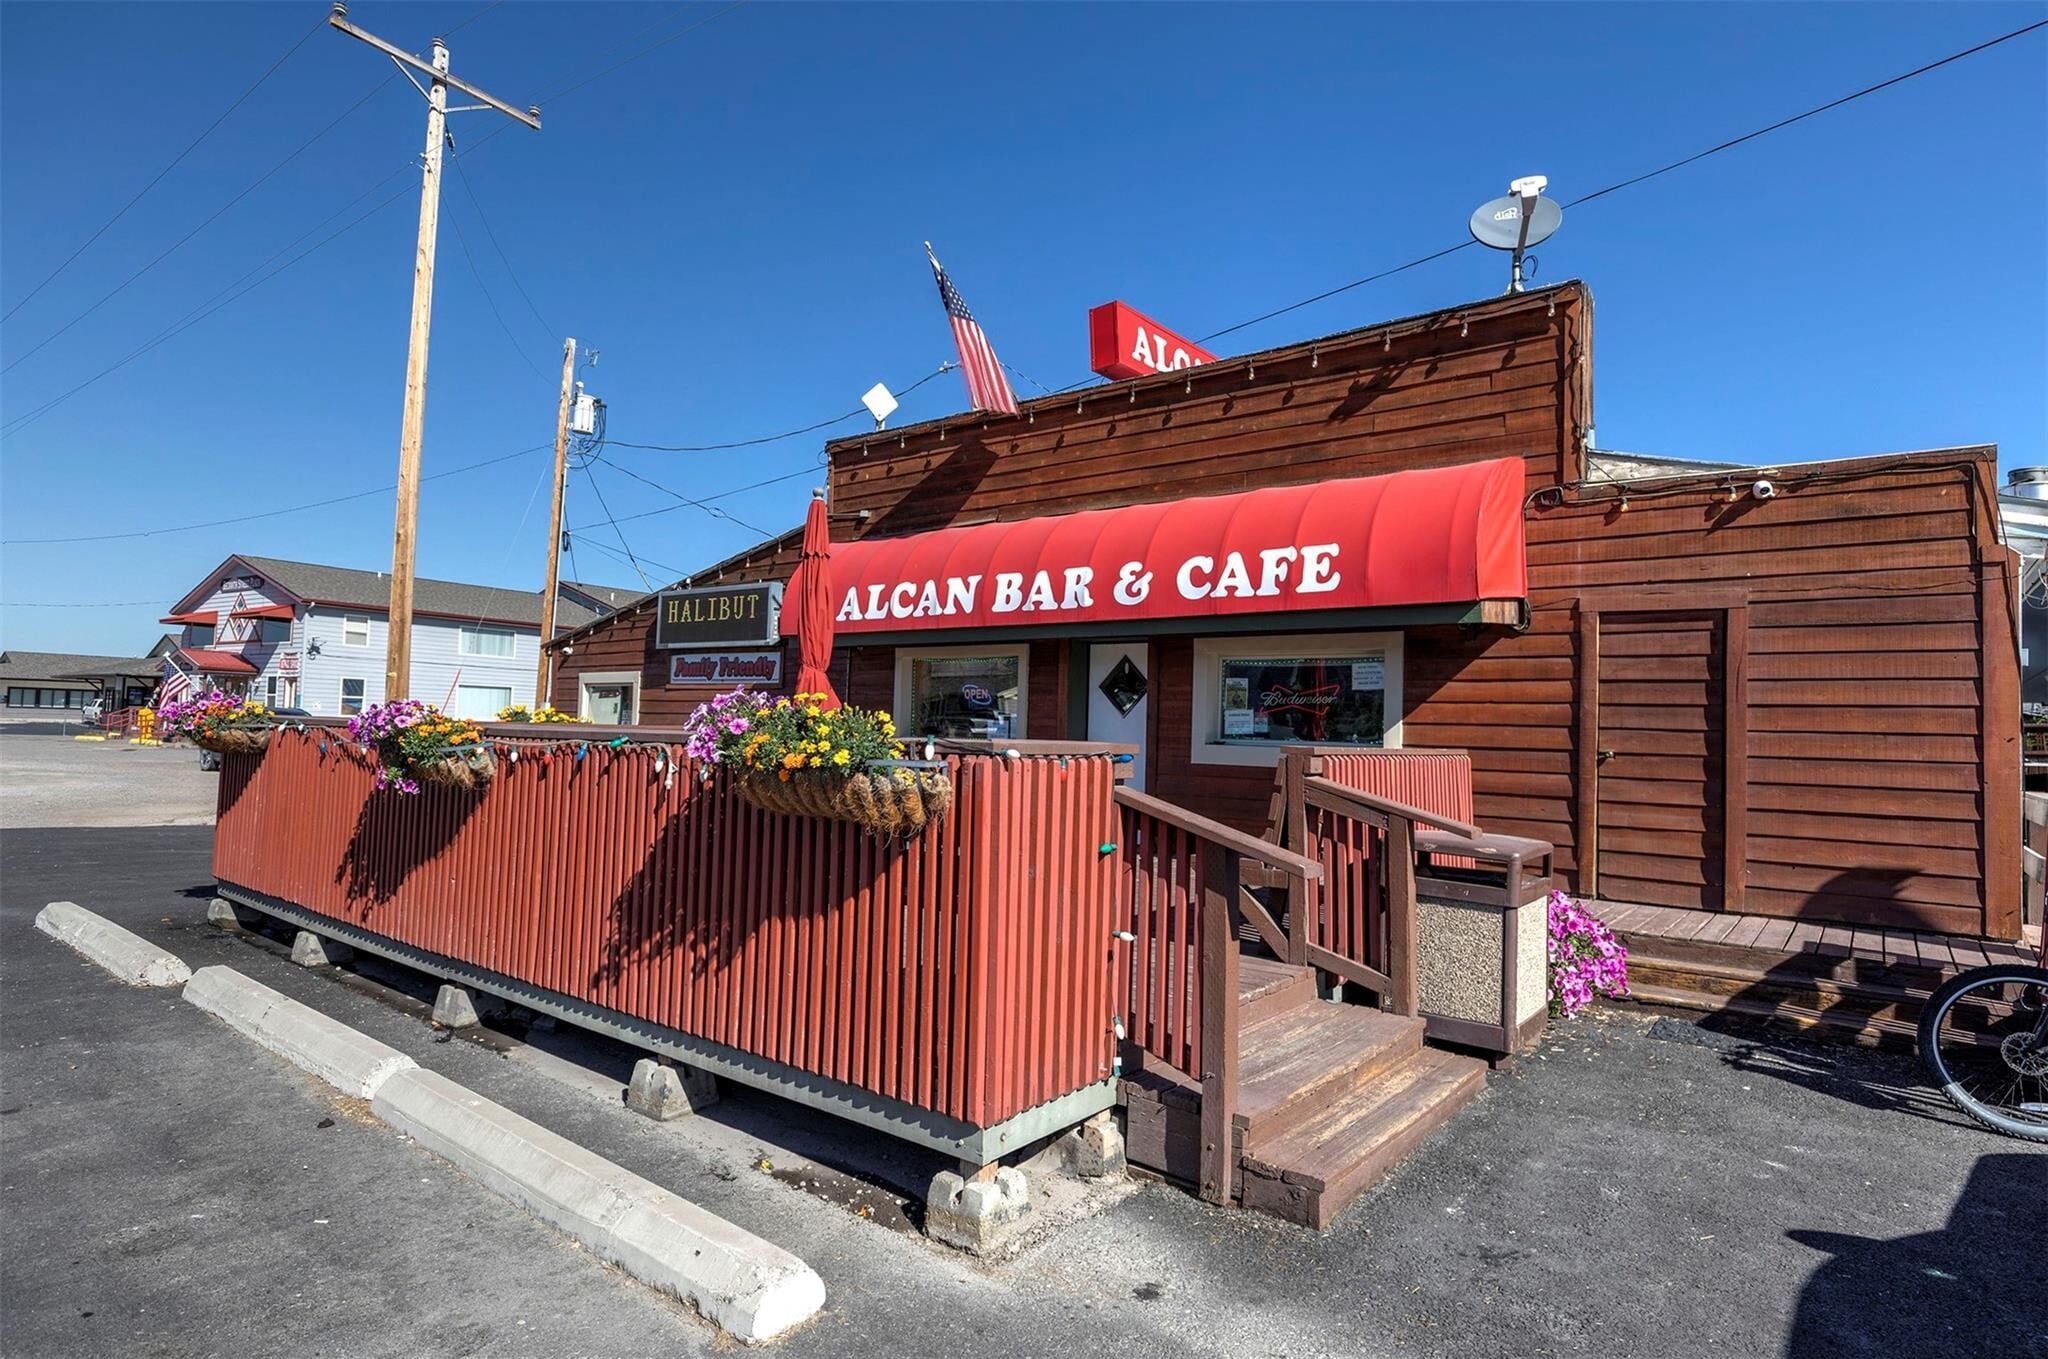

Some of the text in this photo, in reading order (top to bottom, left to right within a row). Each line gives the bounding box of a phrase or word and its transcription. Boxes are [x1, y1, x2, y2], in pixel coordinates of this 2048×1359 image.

[1132, 325, 1201, 373] ALC
[836, 543, 1341, 622] ALCAN BAR & CAFE
[667, 594, 759, 623] HALIBUT
[674, 656, 777, 681] Family Friendly
[964, 689, 989, 700] OPEN
[1260, 691, 1337, 706] Budweiser
